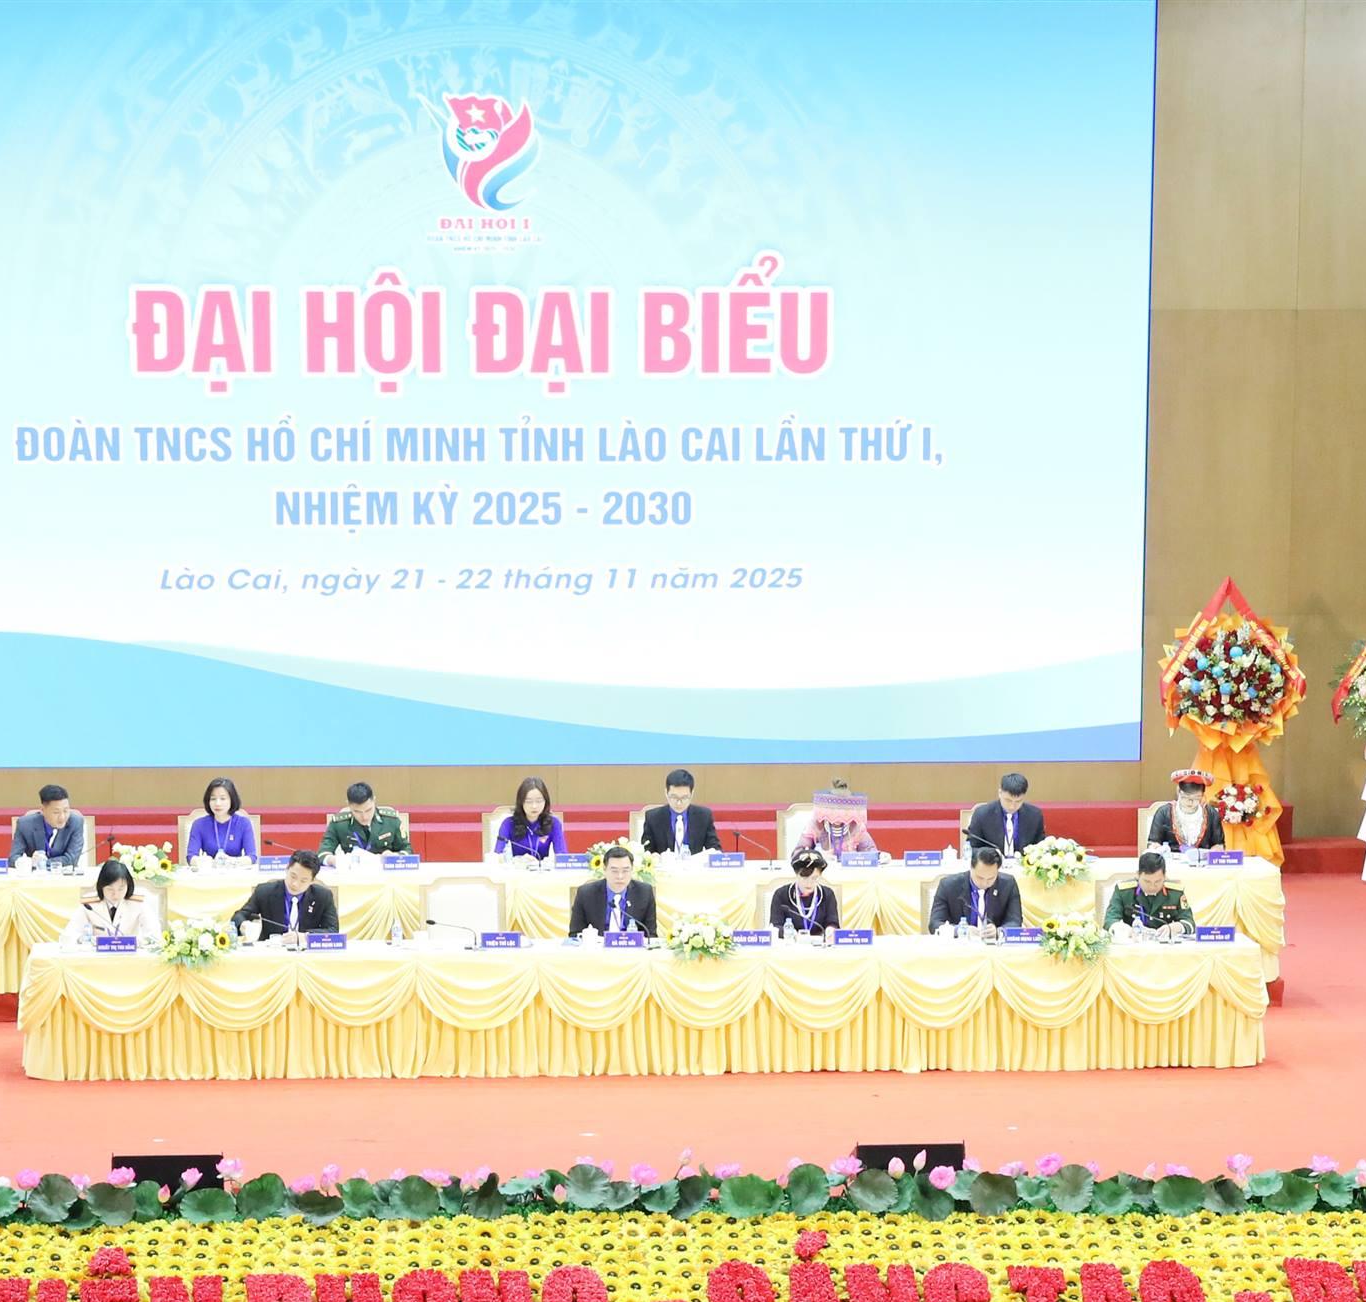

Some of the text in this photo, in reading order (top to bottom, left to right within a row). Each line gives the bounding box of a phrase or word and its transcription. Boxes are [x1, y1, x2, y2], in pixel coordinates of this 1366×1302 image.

[132, 255, 829, 393] ĐẠI HỘI ĐẠI BIỂU
[15, 415, 943, 466] ĐOÀN TNCS HỒ CHÍ MINH TỈNH LÀO CAI LẦN THỨ I,
[276, 484, 398, 533] NHIỆM
[413, 485, 459, 525] KỲ
[472, 491, 562, 525] 2025
[602, 491, 692, 525] 2030
[160, 568, 215, 590] Lào
[227, 569, 289, 593] Cai,
[301, 568, 381, 596] ngày
[390, 569, 425, 590] 21
[455, 568, 494, 590] 22
[503, 566, 593, 596] tháng
[606, 568, 638, 589] 11
[650, 566, 718, 589] năm
[729, 567, 804, 589] 2025
